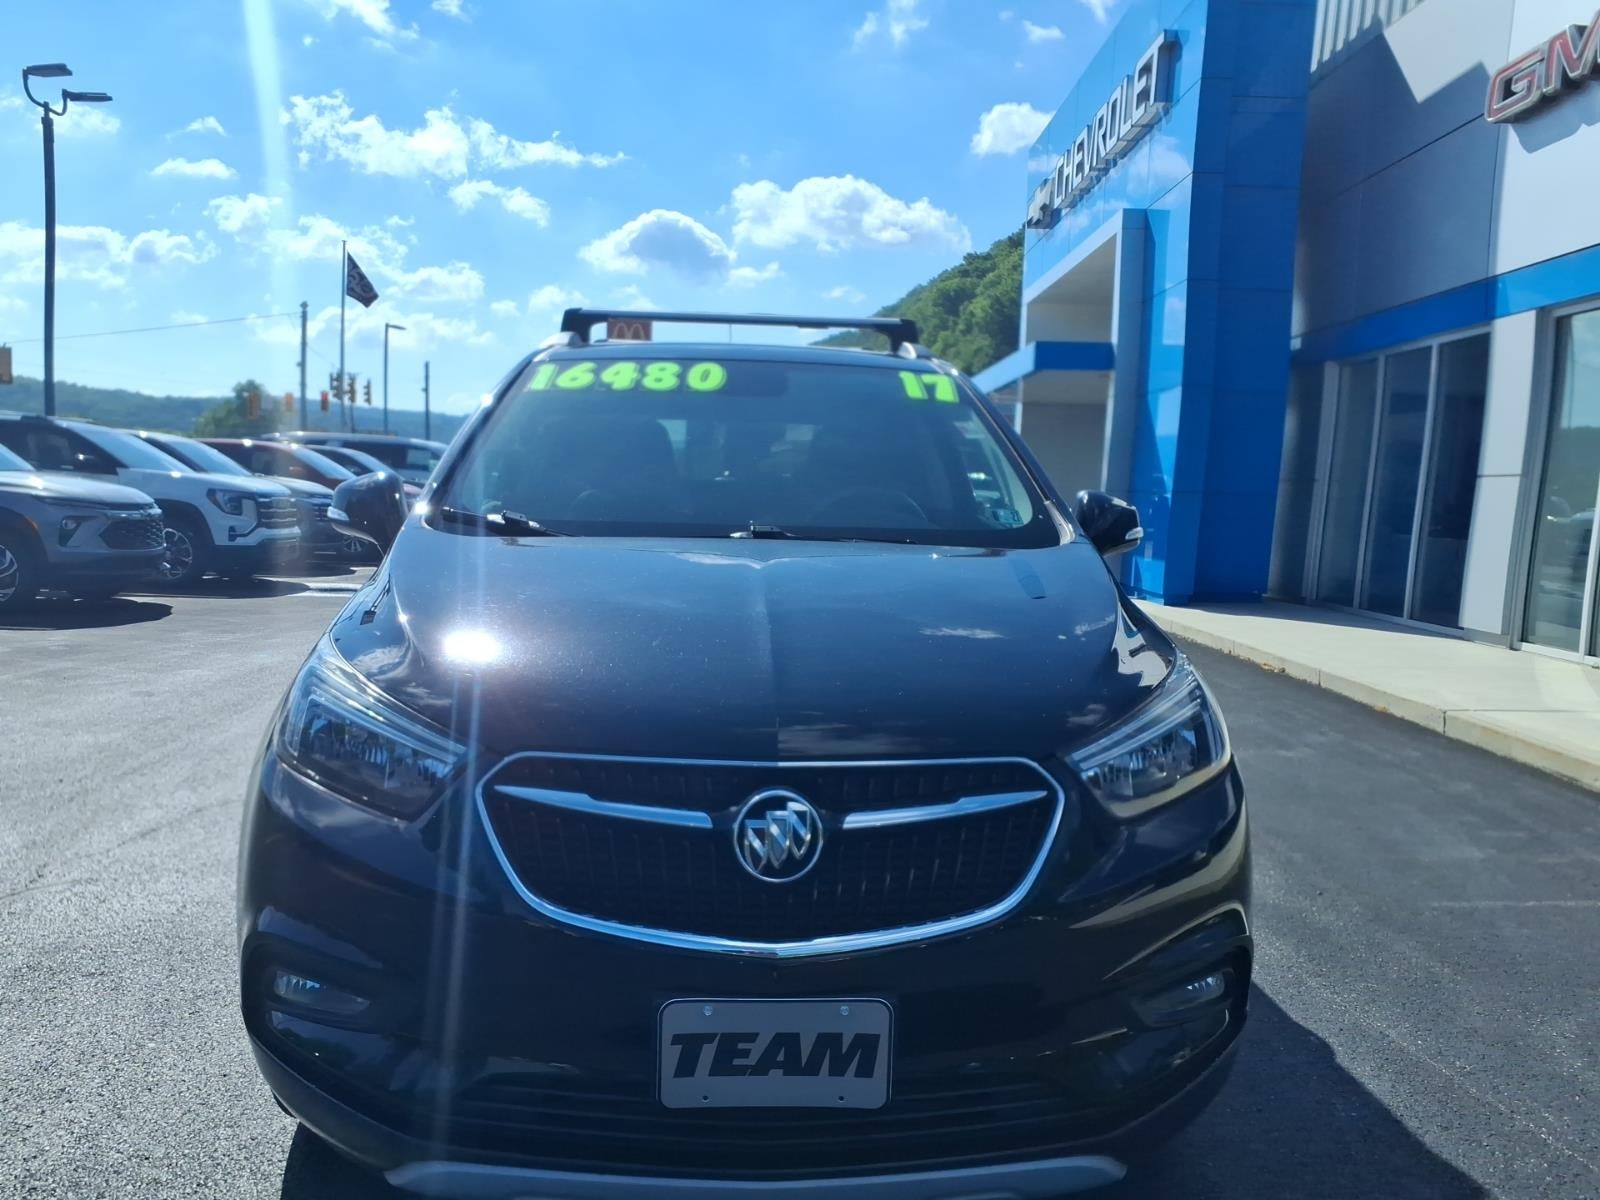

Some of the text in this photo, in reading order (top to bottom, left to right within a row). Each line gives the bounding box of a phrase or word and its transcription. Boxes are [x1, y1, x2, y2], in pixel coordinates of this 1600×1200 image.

[1485, 8, 1600, 122] GM
[1053, 30, 1172, 209] CHEVROLET
[527, 361, 727, 392] 16480
[898, 370, 960, 403] 17
[669, 1031, 881, 1079] TEAM
